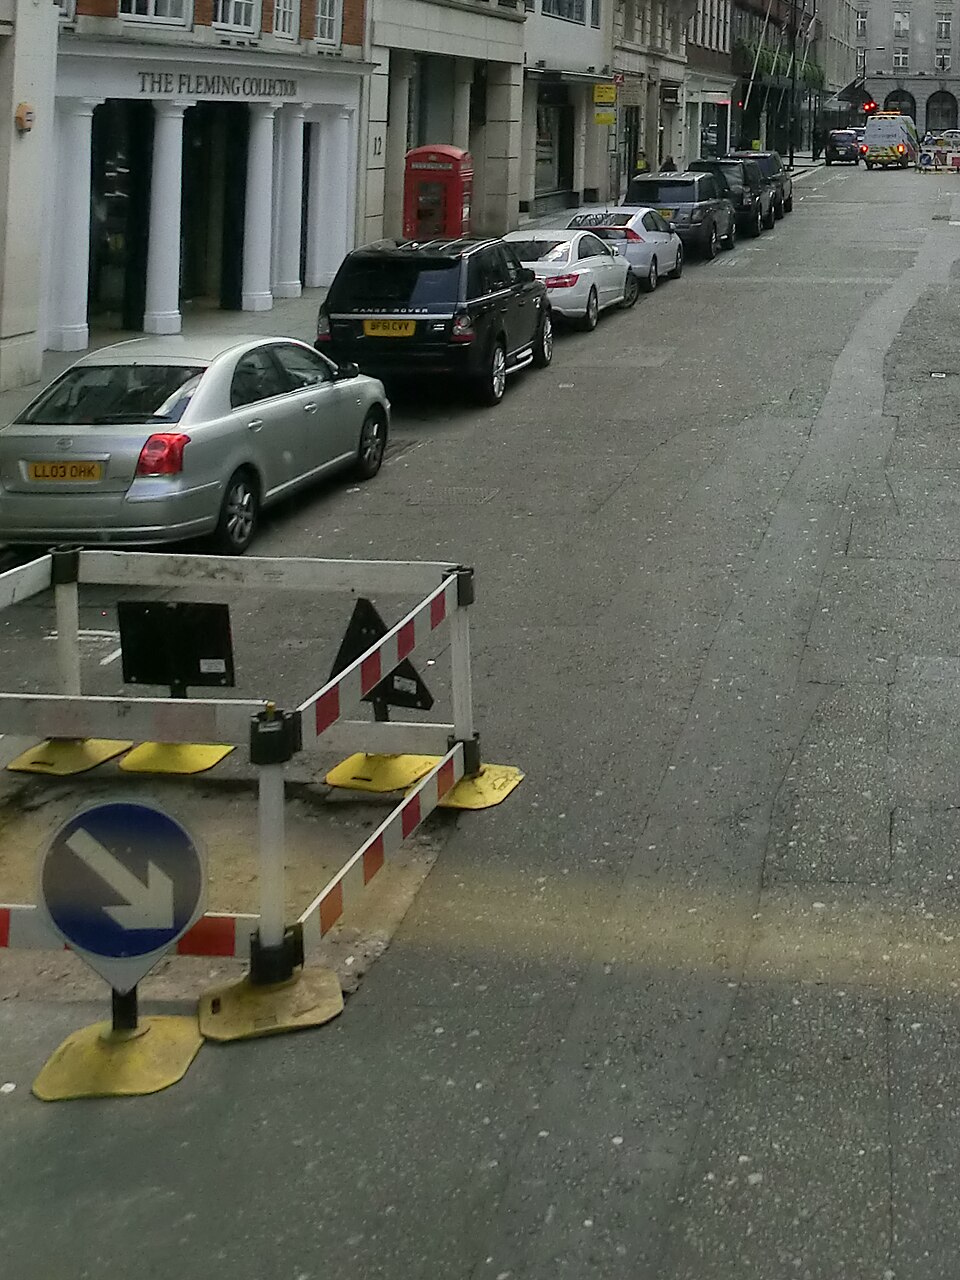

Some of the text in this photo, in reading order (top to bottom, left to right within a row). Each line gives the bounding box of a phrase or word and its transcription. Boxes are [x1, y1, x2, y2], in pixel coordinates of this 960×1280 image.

[138, 72, 298, 97] THE FLEMING COLLECTION
[373, 136, 382, 156] 12
[34, 465, 67, 478] LL03
